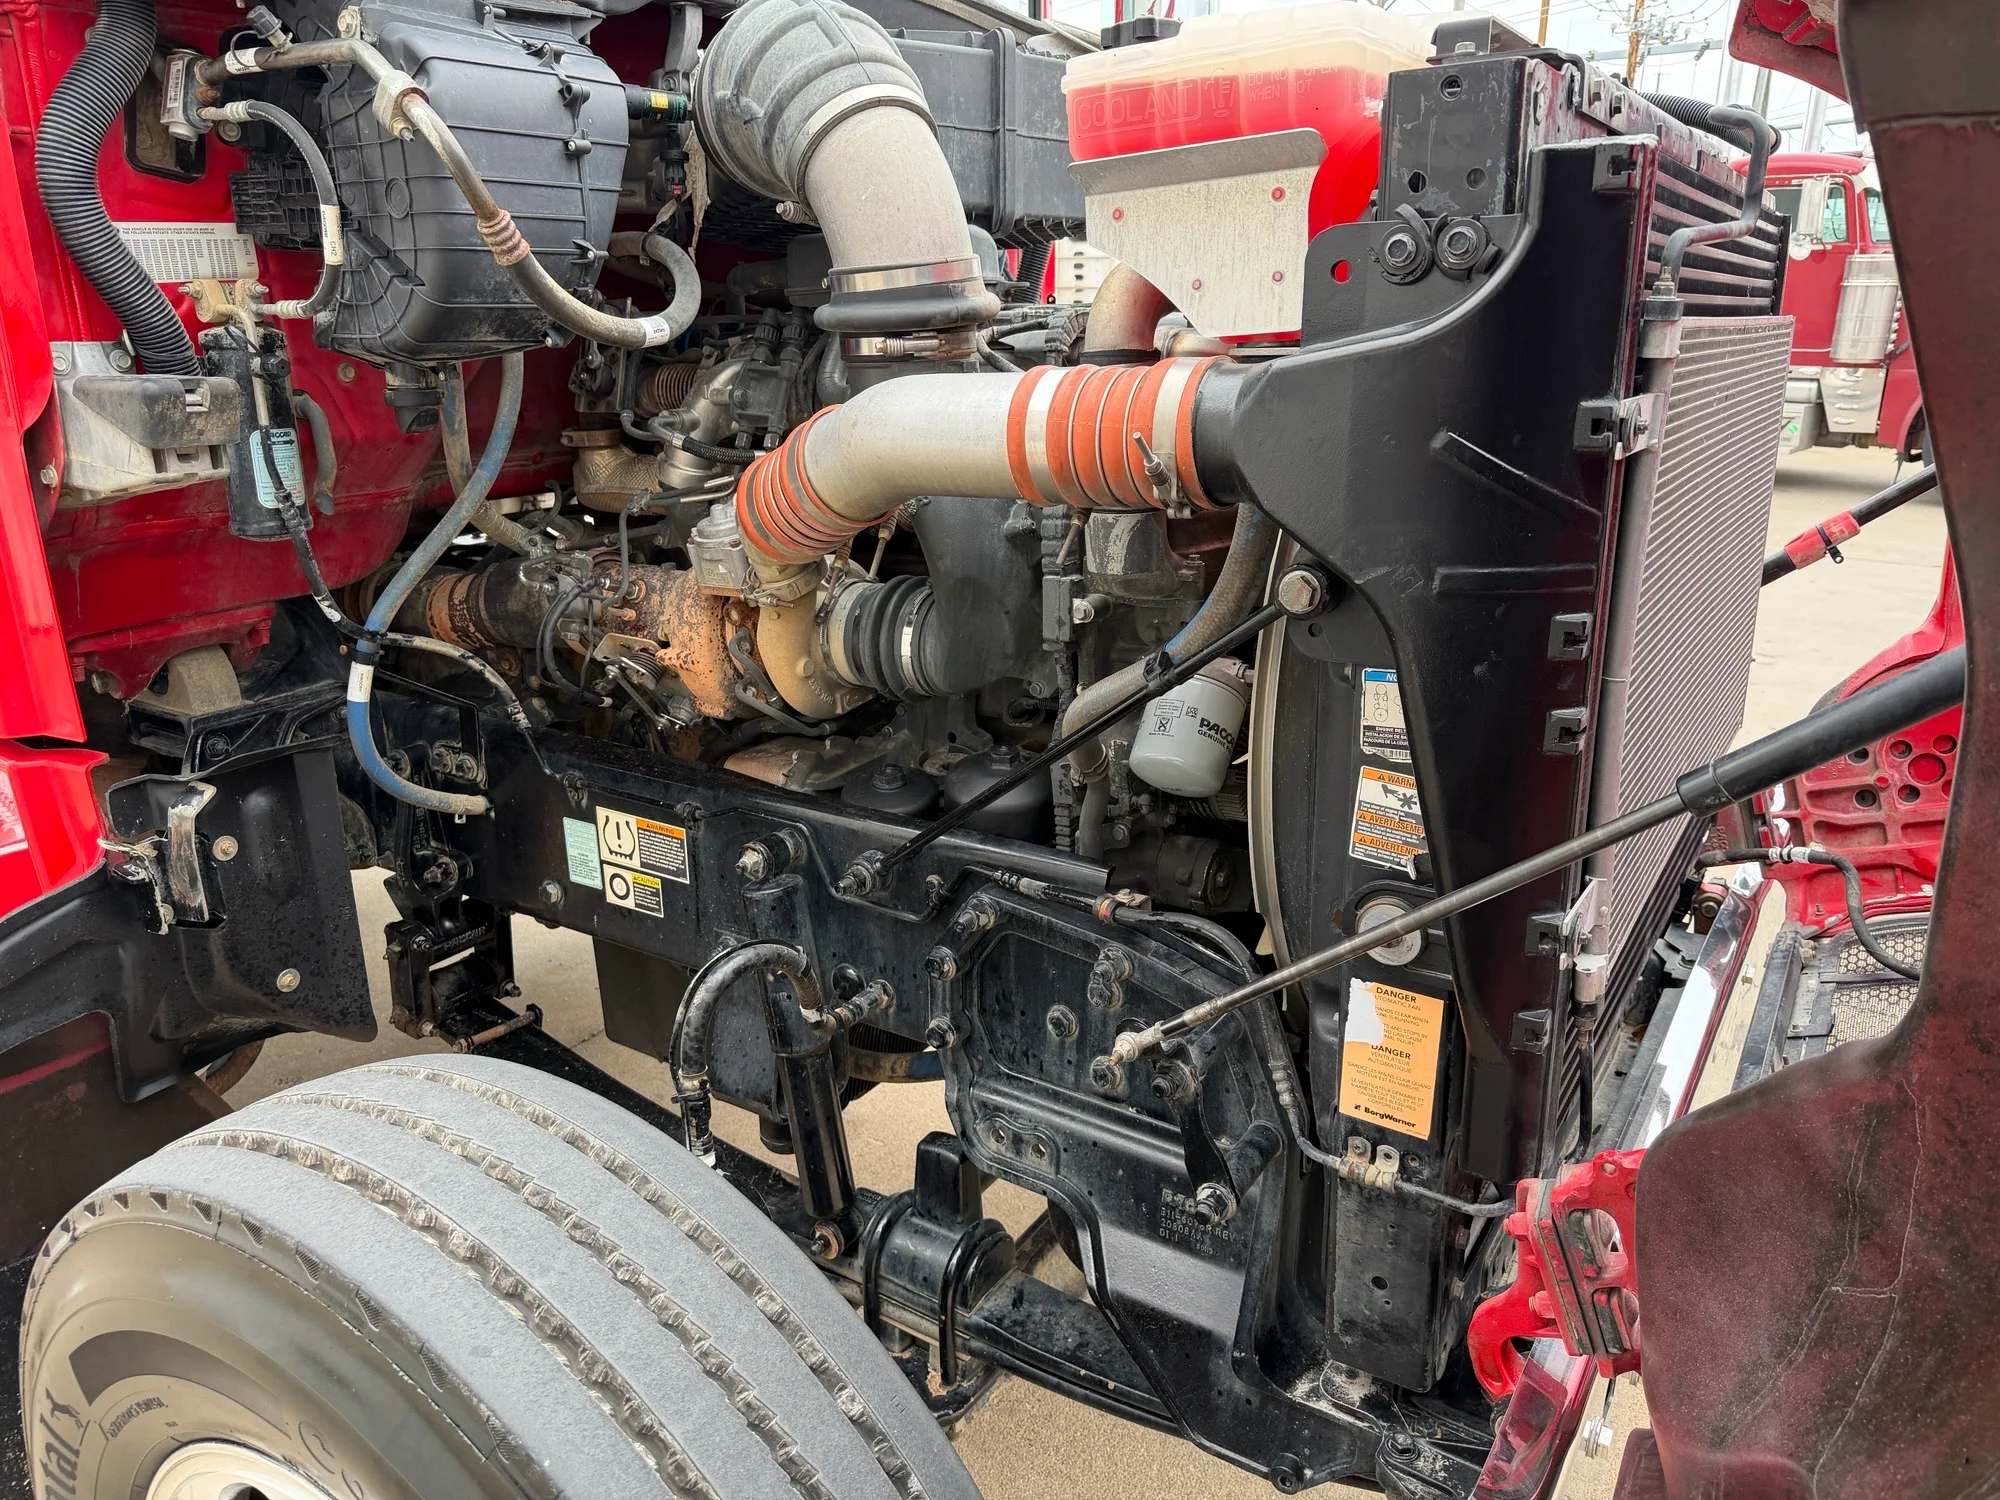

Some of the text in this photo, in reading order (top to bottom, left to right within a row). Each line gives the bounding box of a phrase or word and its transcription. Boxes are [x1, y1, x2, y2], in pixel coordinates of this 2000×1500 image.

[1248, 72, 1264, 87] DO
[1249, 85, 1281, 102] WHEN
[1078, 82, 1194, 130] COOLANT
[1375, 995, 1421, 1011] UTOMATIC FAN
[1376, 987, 1417, 1004] DANGER
[1395, 1010, 1411, 1018] CLEAR
[1412, 1015, 1429, 1024] WHEN
[1403, 1028, 1420, 1037] STOPS
[1405, 1034, 1423, 1043] CAUSE
[1368, 1057, 1412, 1074] AUTOMATIQUE
[1371, 1051, 1411, 1067] VENTILATEUR
[1347, 1062, 1368, 1071] GARDEZ
[1378, 1070, 1395, 1080] MAINS
[1396, 1075, 1411, 1084] CLAIR
[1412, 1080, 1432, 1090] QUAND
[1356, 1069, 1378, 1079] MOTEUR
[1358, 1079, 1392, 1094] VENTILATEUR
[1357, 1090, 1377, 1099] CAUSER
[1388, 1098, 1416, 1111] BLESSURES
[1375, 1089, 1389, 1098] TOUT
[1390, 1094, 1403, 1102] SEUL
[1410, 1100, 1424, 1108] PEUT
[1364, 1106, 1416, 1128] BorgWarner
